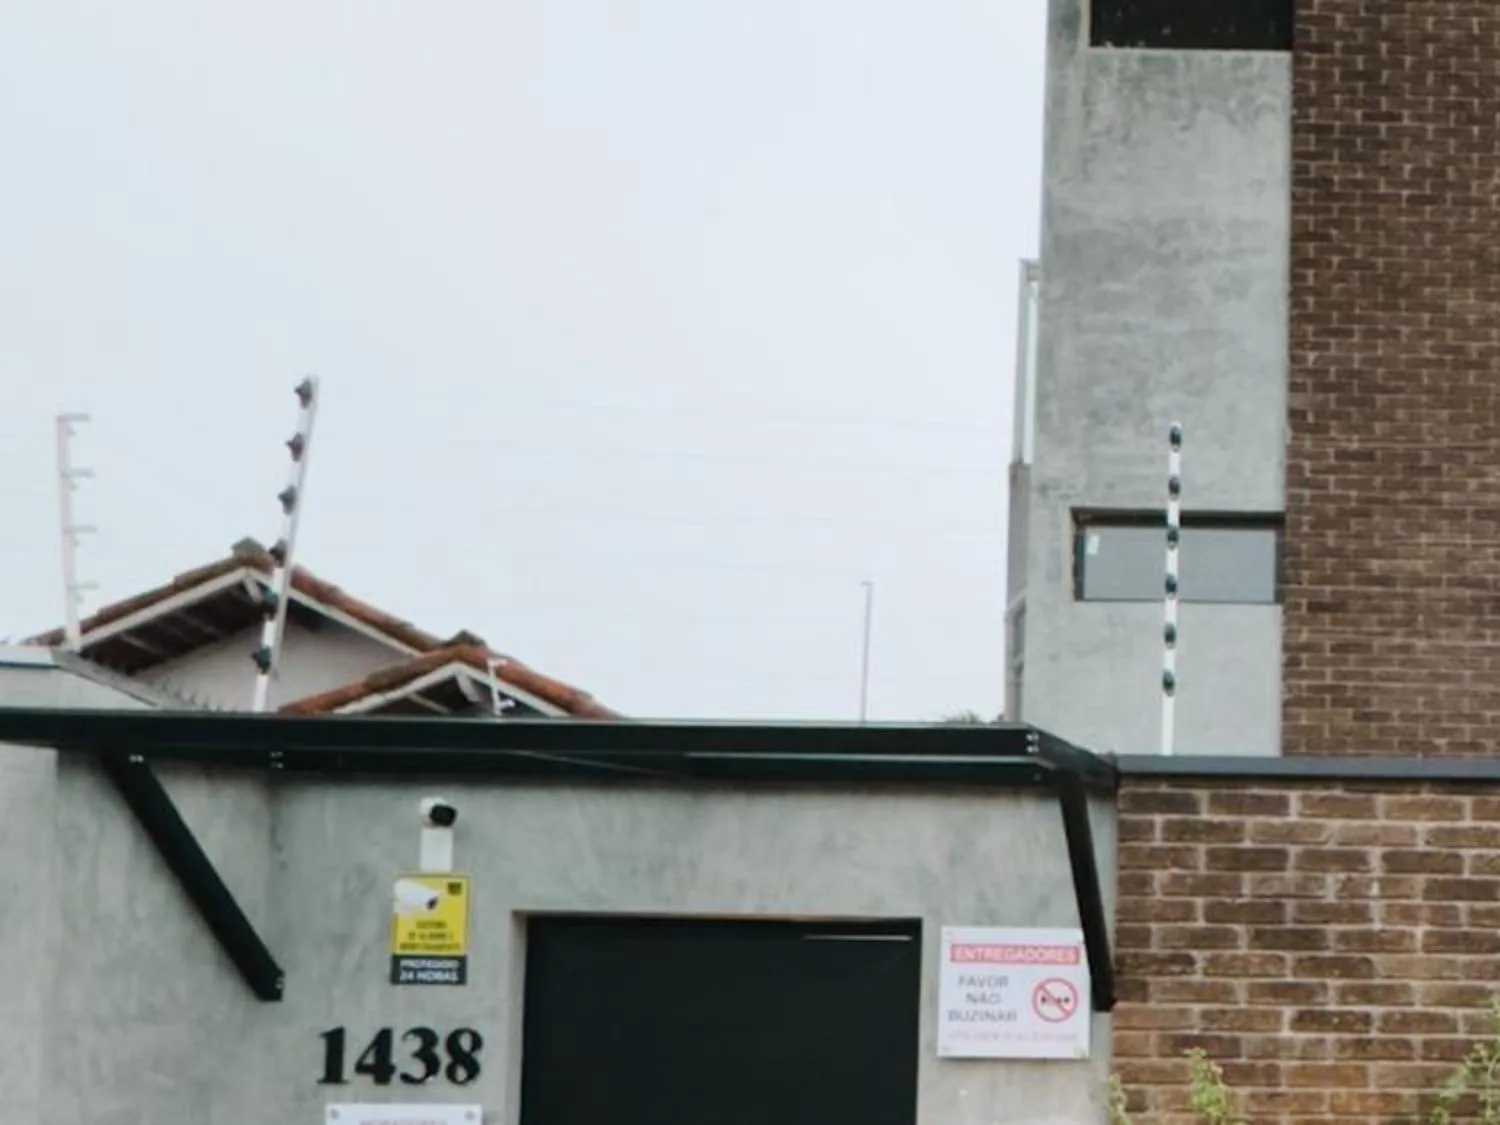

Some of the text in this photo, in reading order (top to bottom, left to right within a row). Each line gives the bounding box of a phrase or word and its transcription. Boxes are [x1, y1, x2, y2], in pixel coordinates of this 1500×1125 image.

[955, 946, 1078, 963] ENTREGADORES
[417, 970, 458, 981] HORAS
[958, 975, 1008, 988] FAVOR
[965, 991, 1001, 1005] NÃO
[947, 1010, 1018, 1022] BUZINAR
[317, 1025, 483, 1085] 1438
